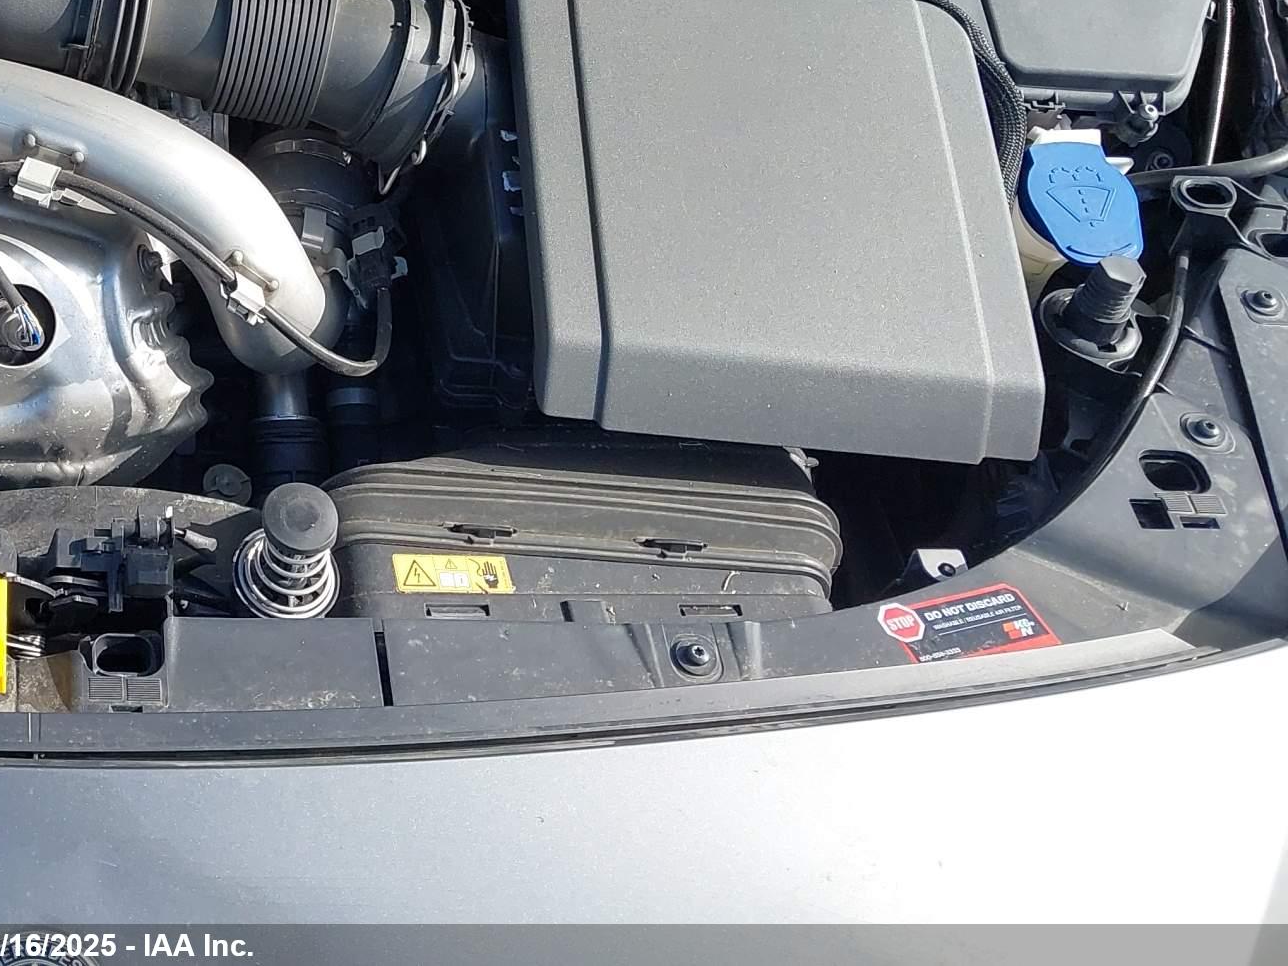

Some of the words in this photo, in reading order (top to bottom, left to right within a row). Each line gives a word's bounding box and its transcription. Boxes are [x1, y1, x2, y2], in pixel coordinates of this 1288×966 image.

[924, 611, 940, 621] DO
[944, 604, 965, 617] NOT
[967, 593, 1016, 612] DISCARD
[885, 615, 915, 632] STOP
